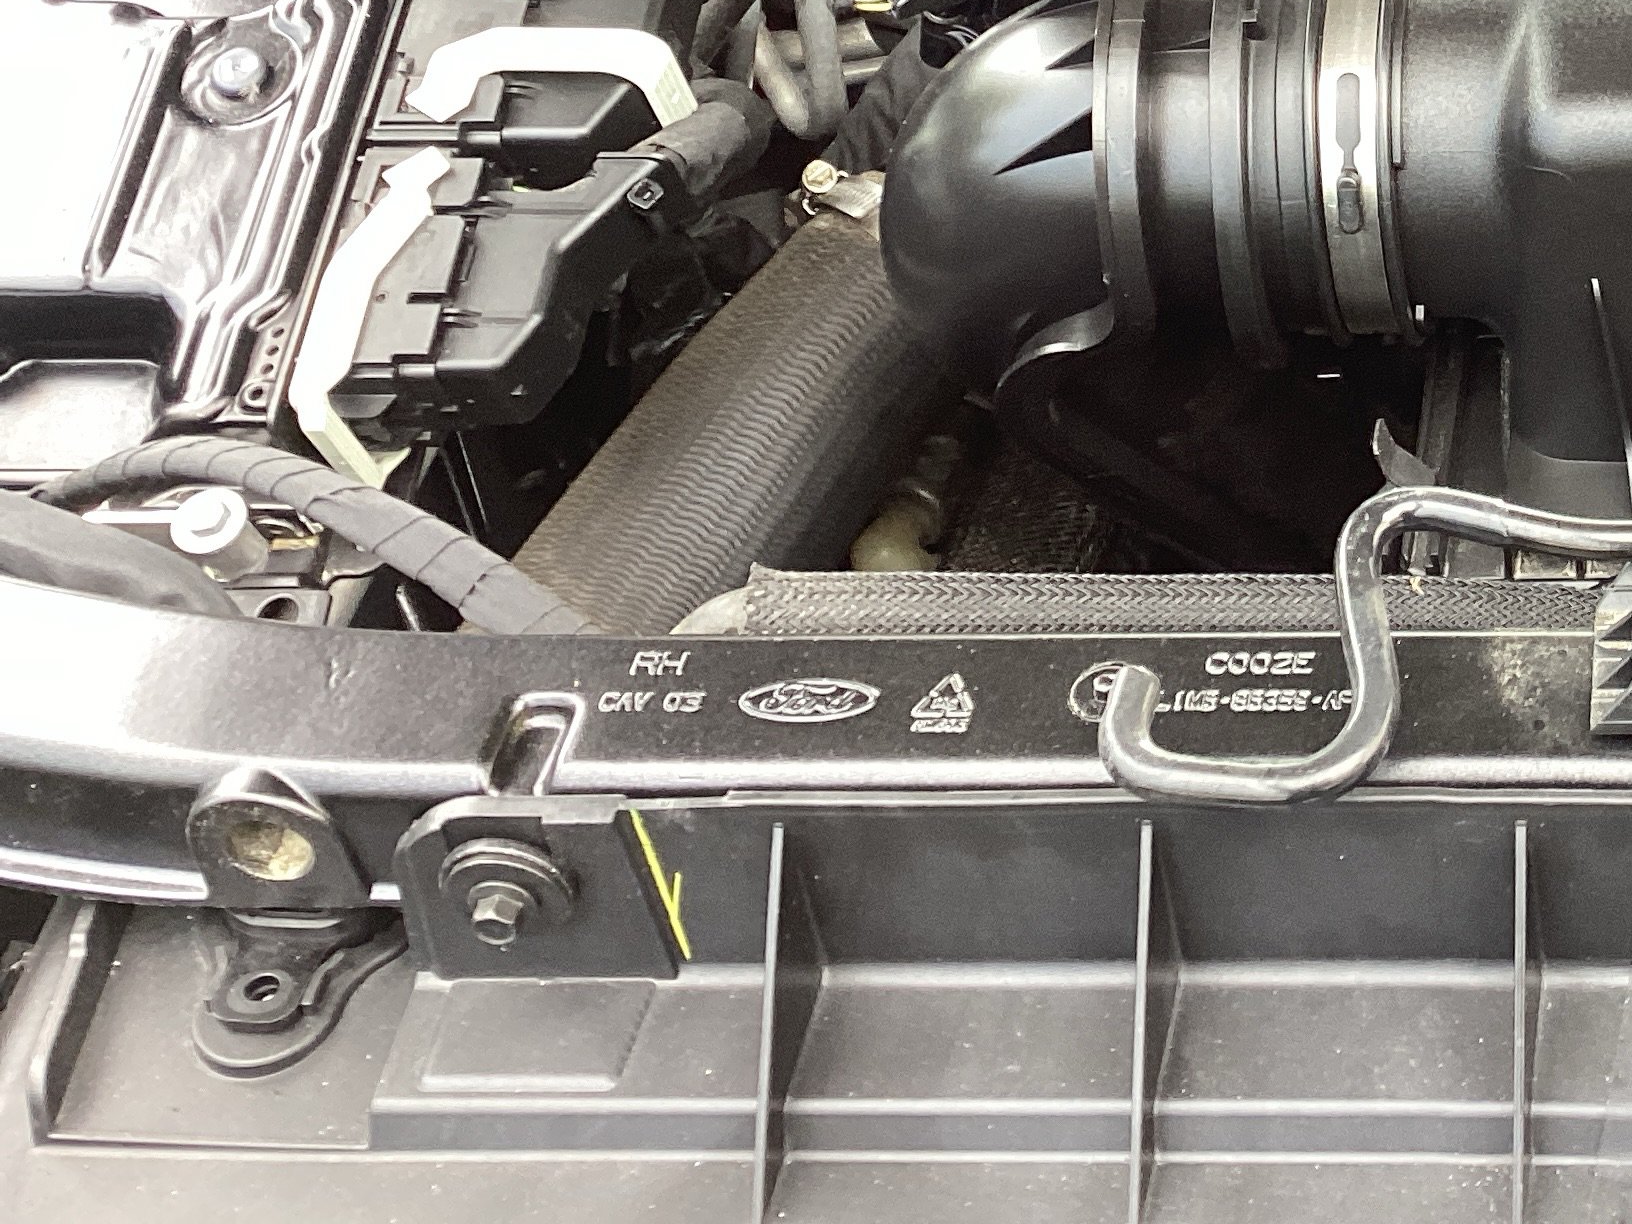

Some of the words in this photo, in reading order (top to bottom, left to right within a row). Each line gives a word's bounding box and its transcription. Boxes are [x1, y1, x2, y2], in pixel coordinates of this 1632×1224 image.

[629, 650, 691, 676] RH
[598, 691, 656, 713] CAV
[757, 681, 858, 716] Ford
